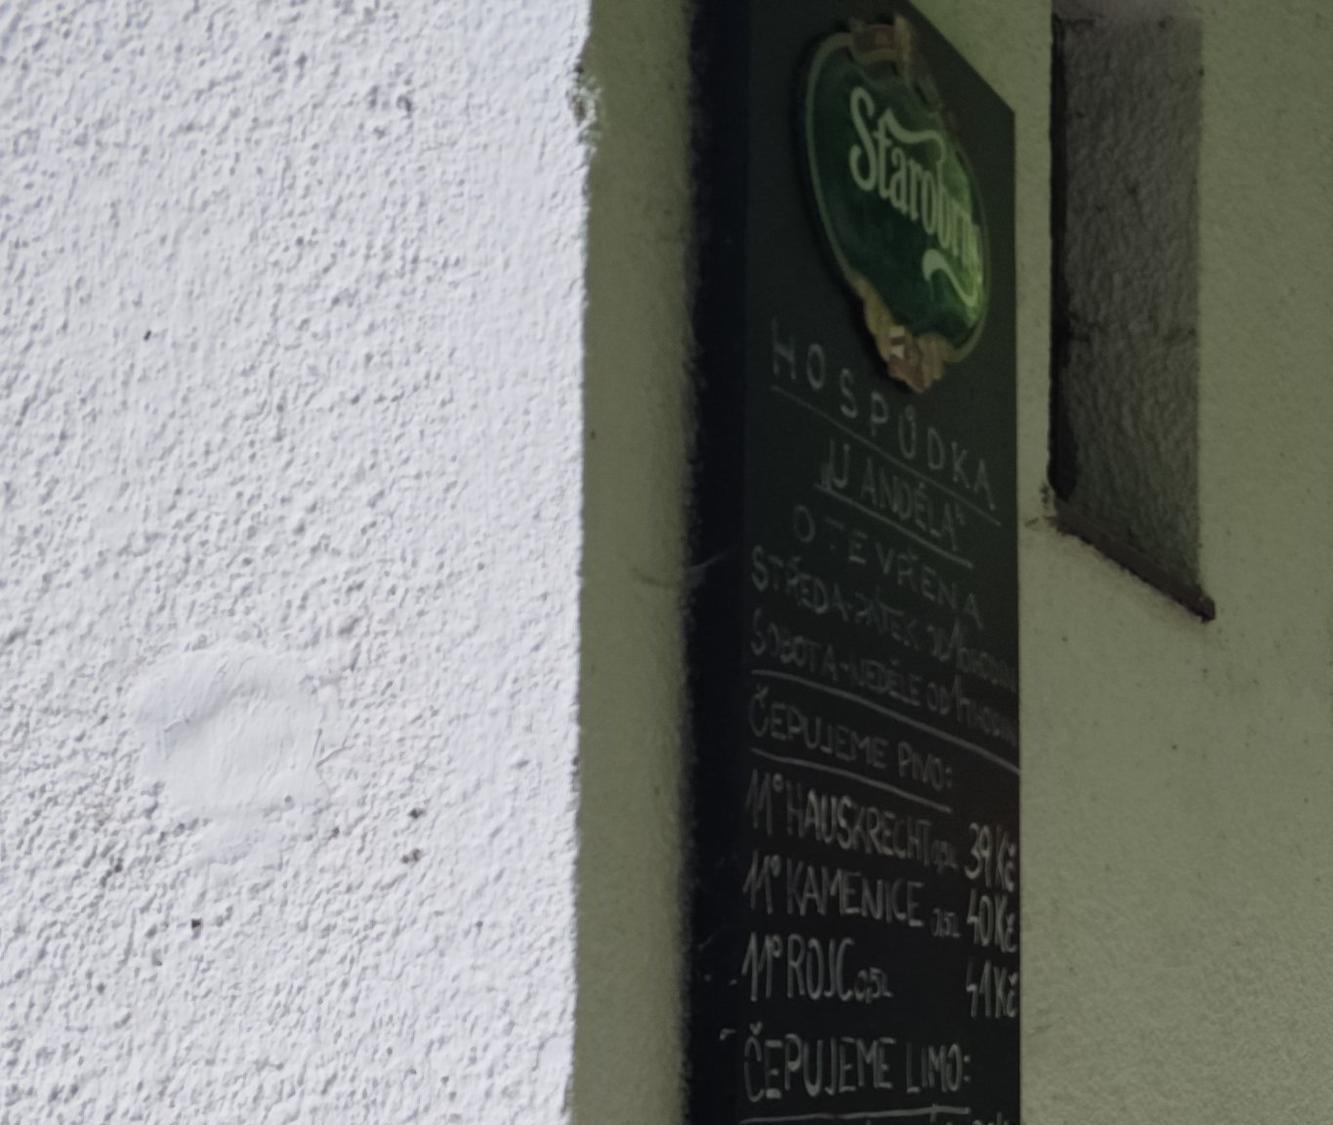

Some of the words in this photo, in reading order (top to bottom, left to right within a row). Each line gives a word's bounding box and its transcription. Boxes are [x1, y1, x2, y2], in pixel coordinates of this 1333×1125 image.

[748, 684, 889, 770] ČEPUJEME
[786, 856, 925, 928] KAMENICE
[744, 1020, 896, 1102] ČEPUJEME
[905, 1042, 971, 1094] LIMO:
